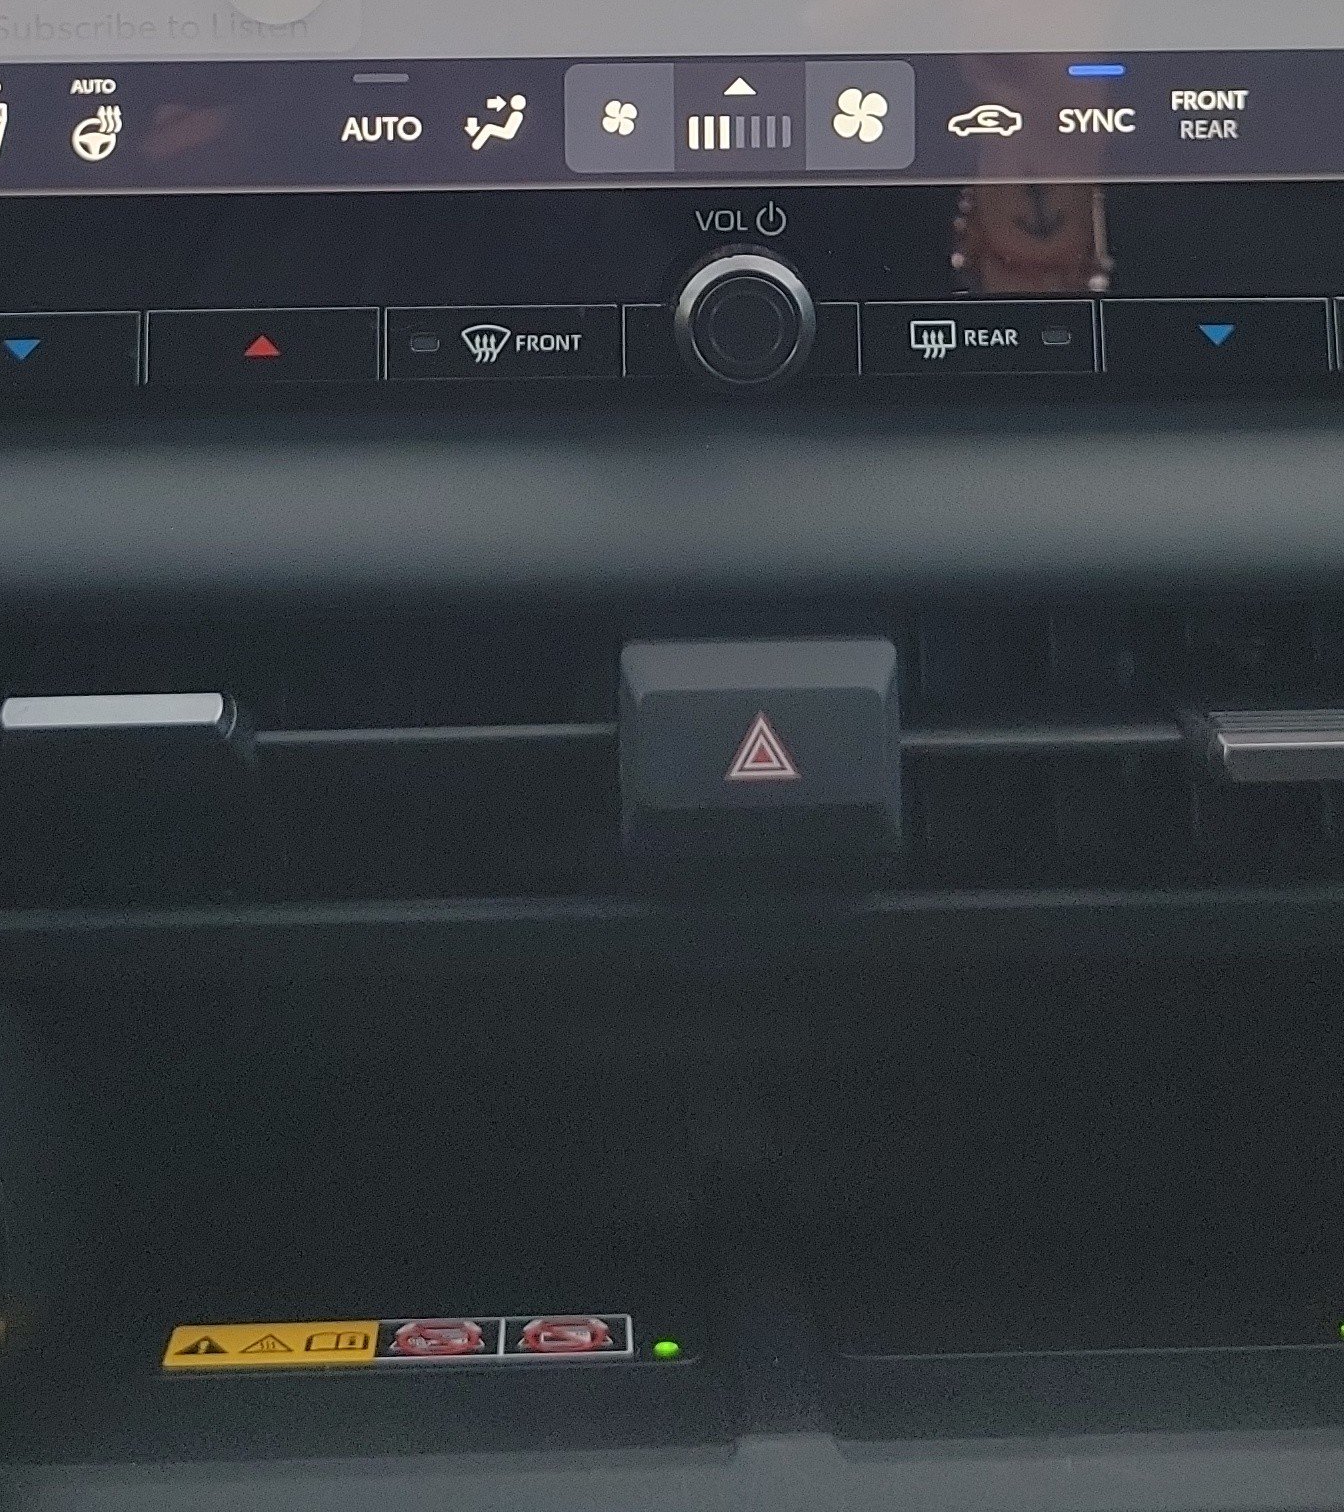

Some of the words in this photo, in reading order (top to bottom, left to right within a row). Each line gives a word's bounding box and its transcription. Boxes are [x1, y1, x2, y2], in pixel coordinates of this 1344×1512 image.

[168, 16, 201, 39] to
[71, 78, 116, 95] AUTO
[1170, 89, 1248, 112] FRONT
[342, 116, 423, 143] AUTO
[1058, 108, 1136, 134] SYNC
[1179, 119, 1239, 140] REAR
[695, 209, 749, 233] VOL
[515, 332, 581, 353] FRONT
[963, 327, 1018, 348] REAR
